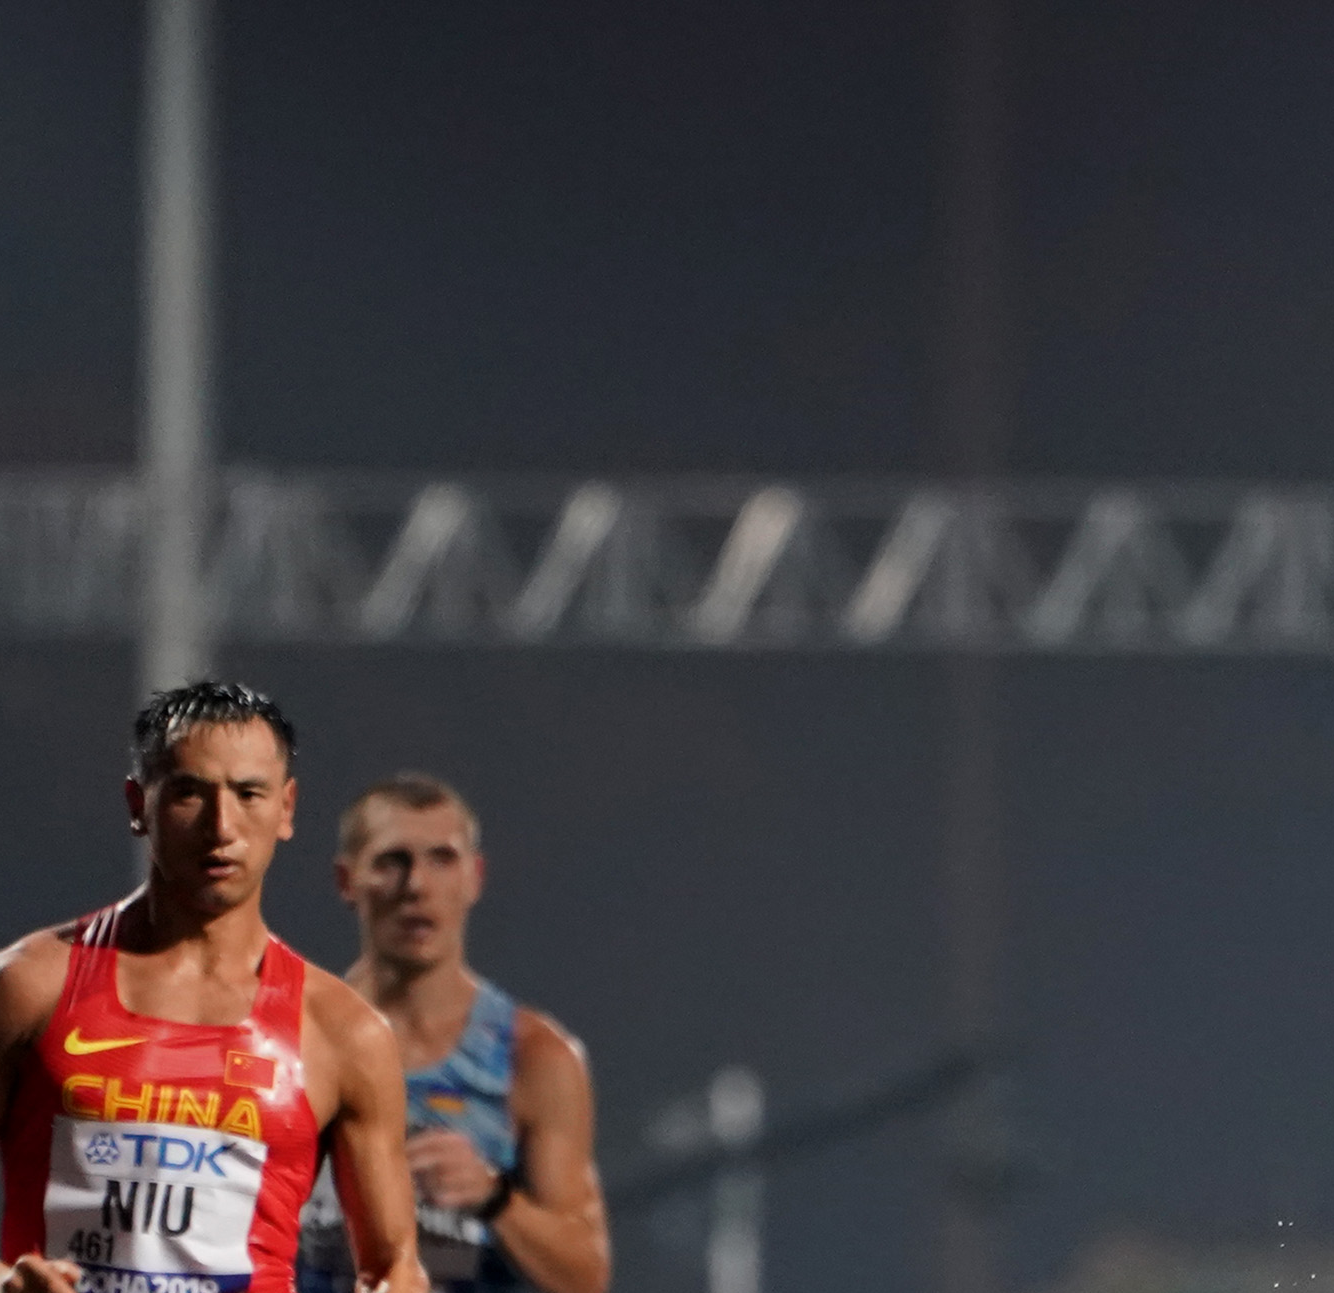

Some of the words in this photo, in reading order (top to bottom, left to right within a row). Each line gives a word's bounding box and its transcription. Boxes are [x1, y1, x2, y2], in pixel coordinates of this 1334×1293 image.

[62, 1074, 262, 1141] CHINA
[121, 1133, 227, 1178] TDK
[101, 1180, 195, 1237] NIU
[68, 1229, 115, 1264] 461
